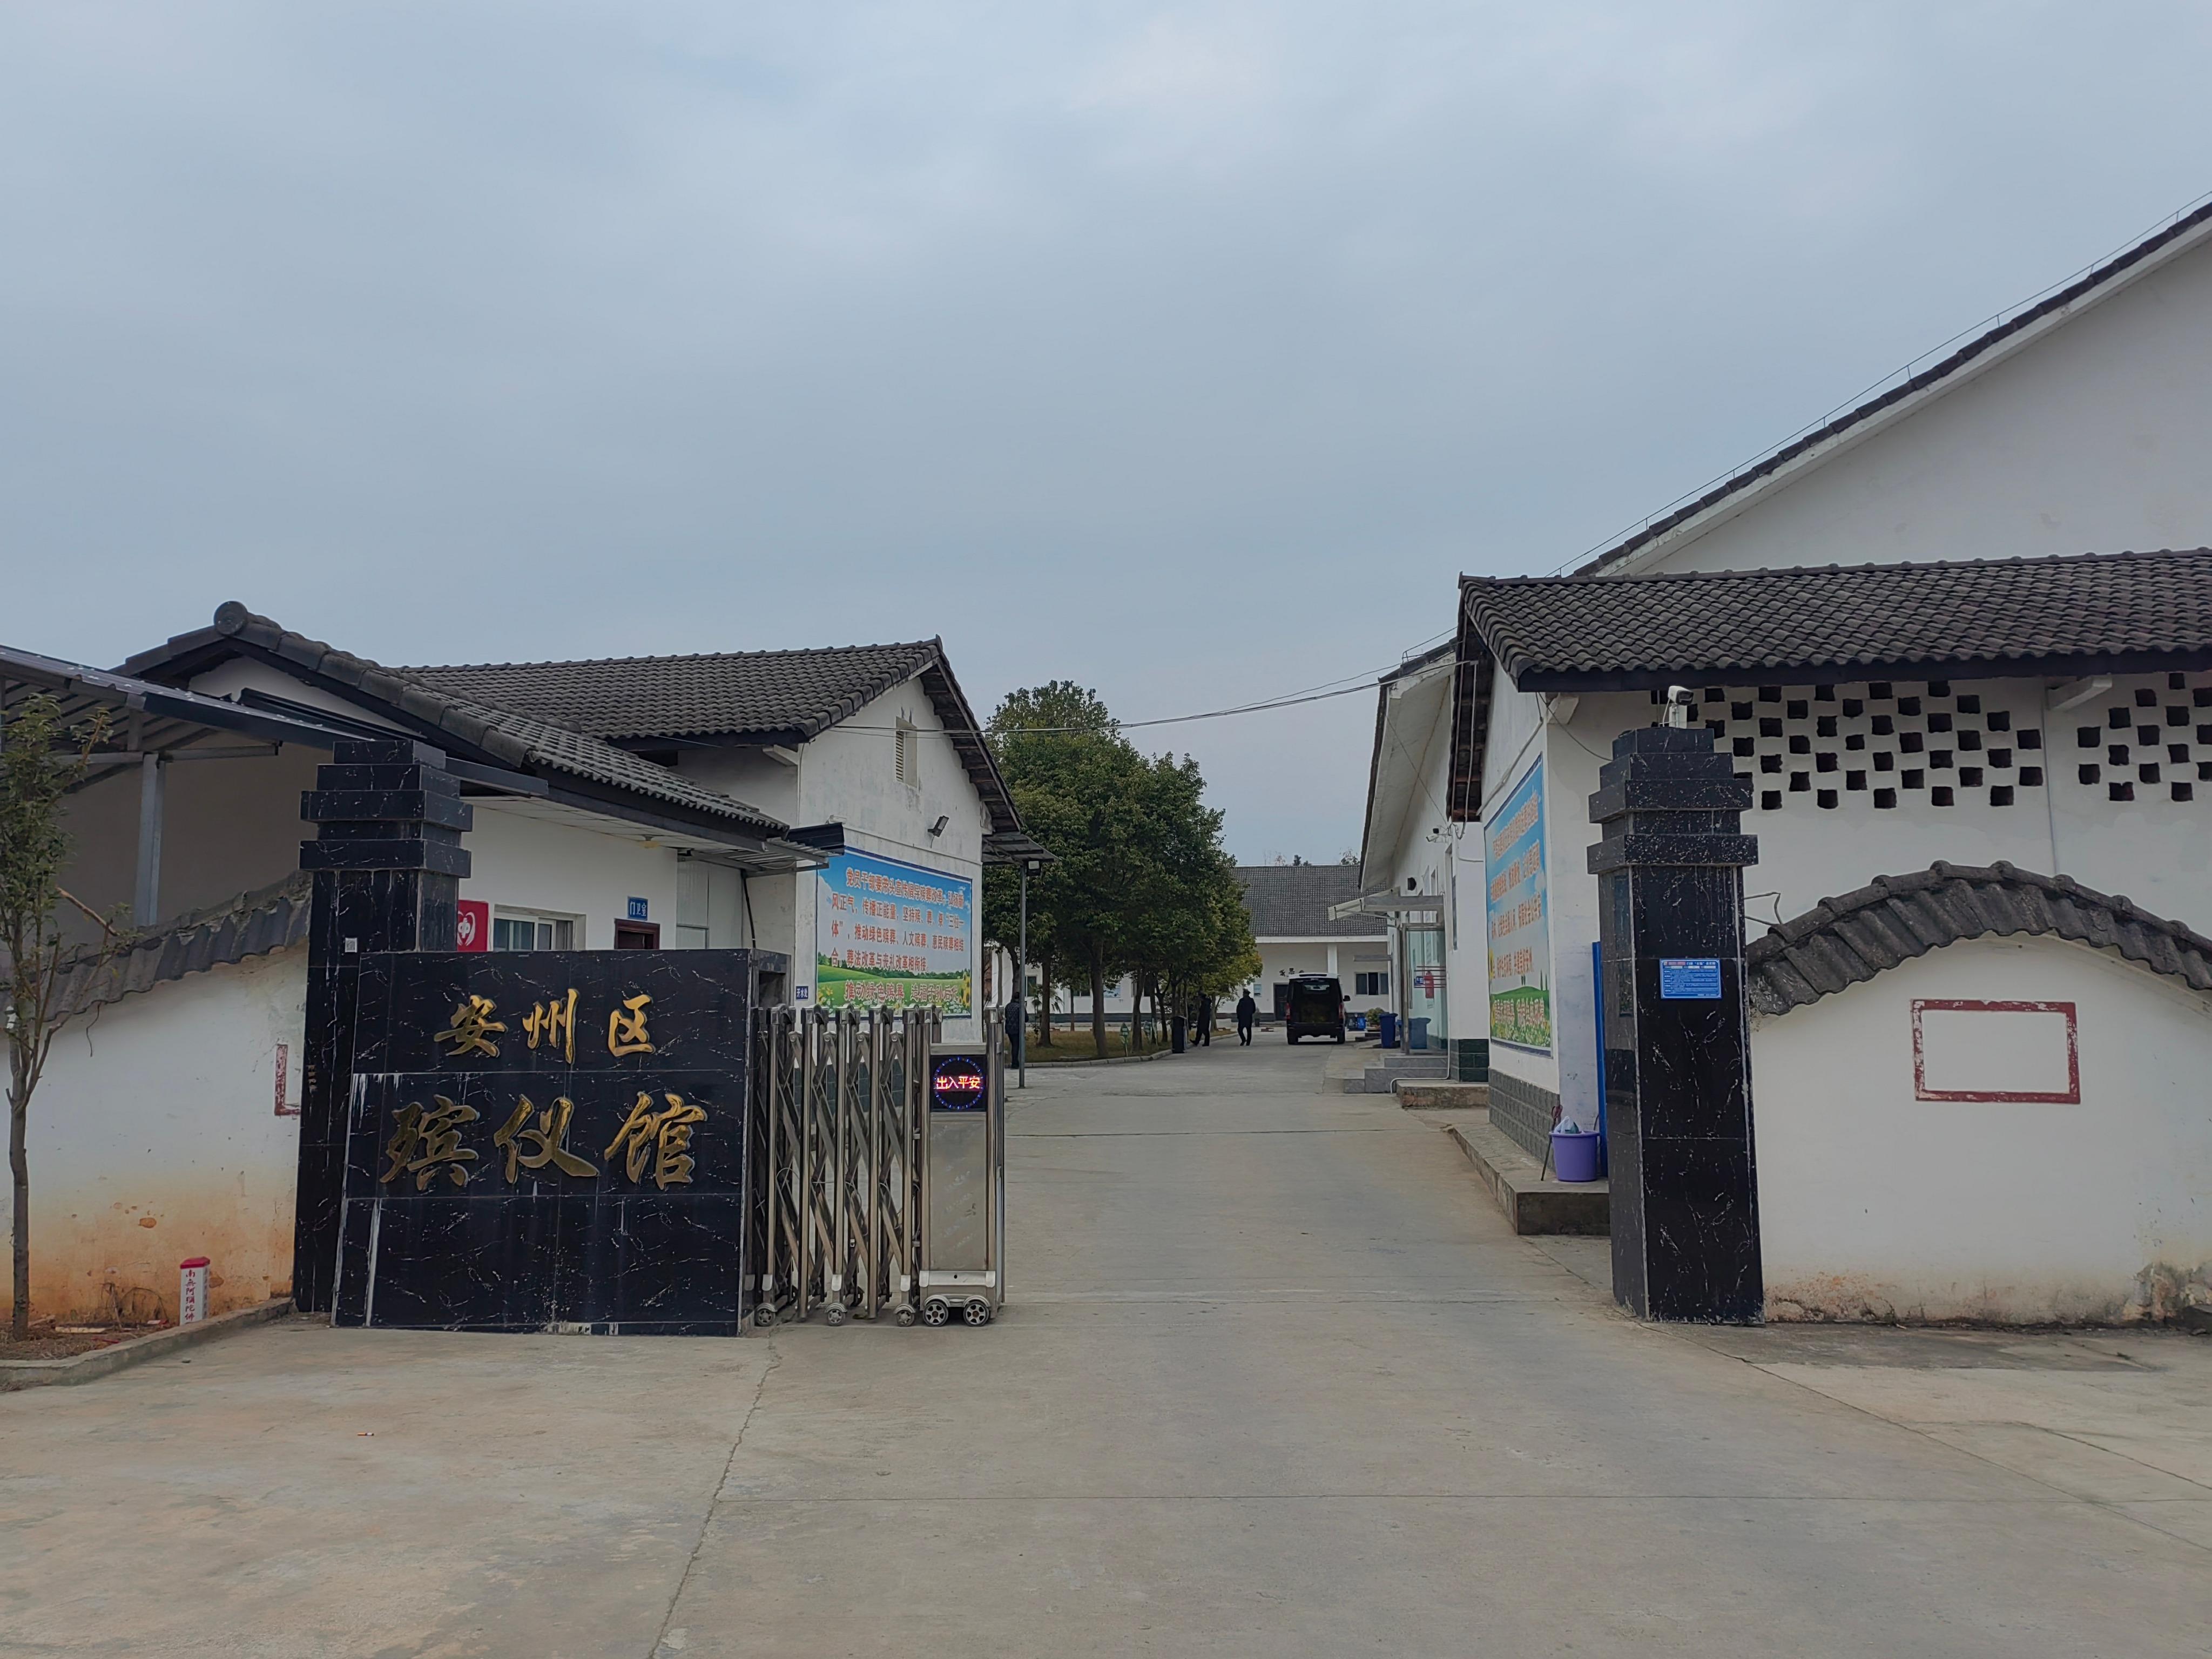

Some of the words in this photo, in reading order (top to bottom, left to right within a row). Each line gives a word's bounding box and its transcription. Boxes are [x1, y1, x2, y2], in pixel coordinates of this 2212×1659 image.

[630, 901, 647, 916] 门卫室
[797, 987, 808, 998] 开水处
[845, 980, 904, 1001] 推动绿色殡葬
[911, 983, 959, 1003] 造福子孙后代
[434, 988, 657, 1064] 安州区
[936, 1076, 981, 1089] 出入平安
[379, 1091, 709, 1190] 殡仪馆
